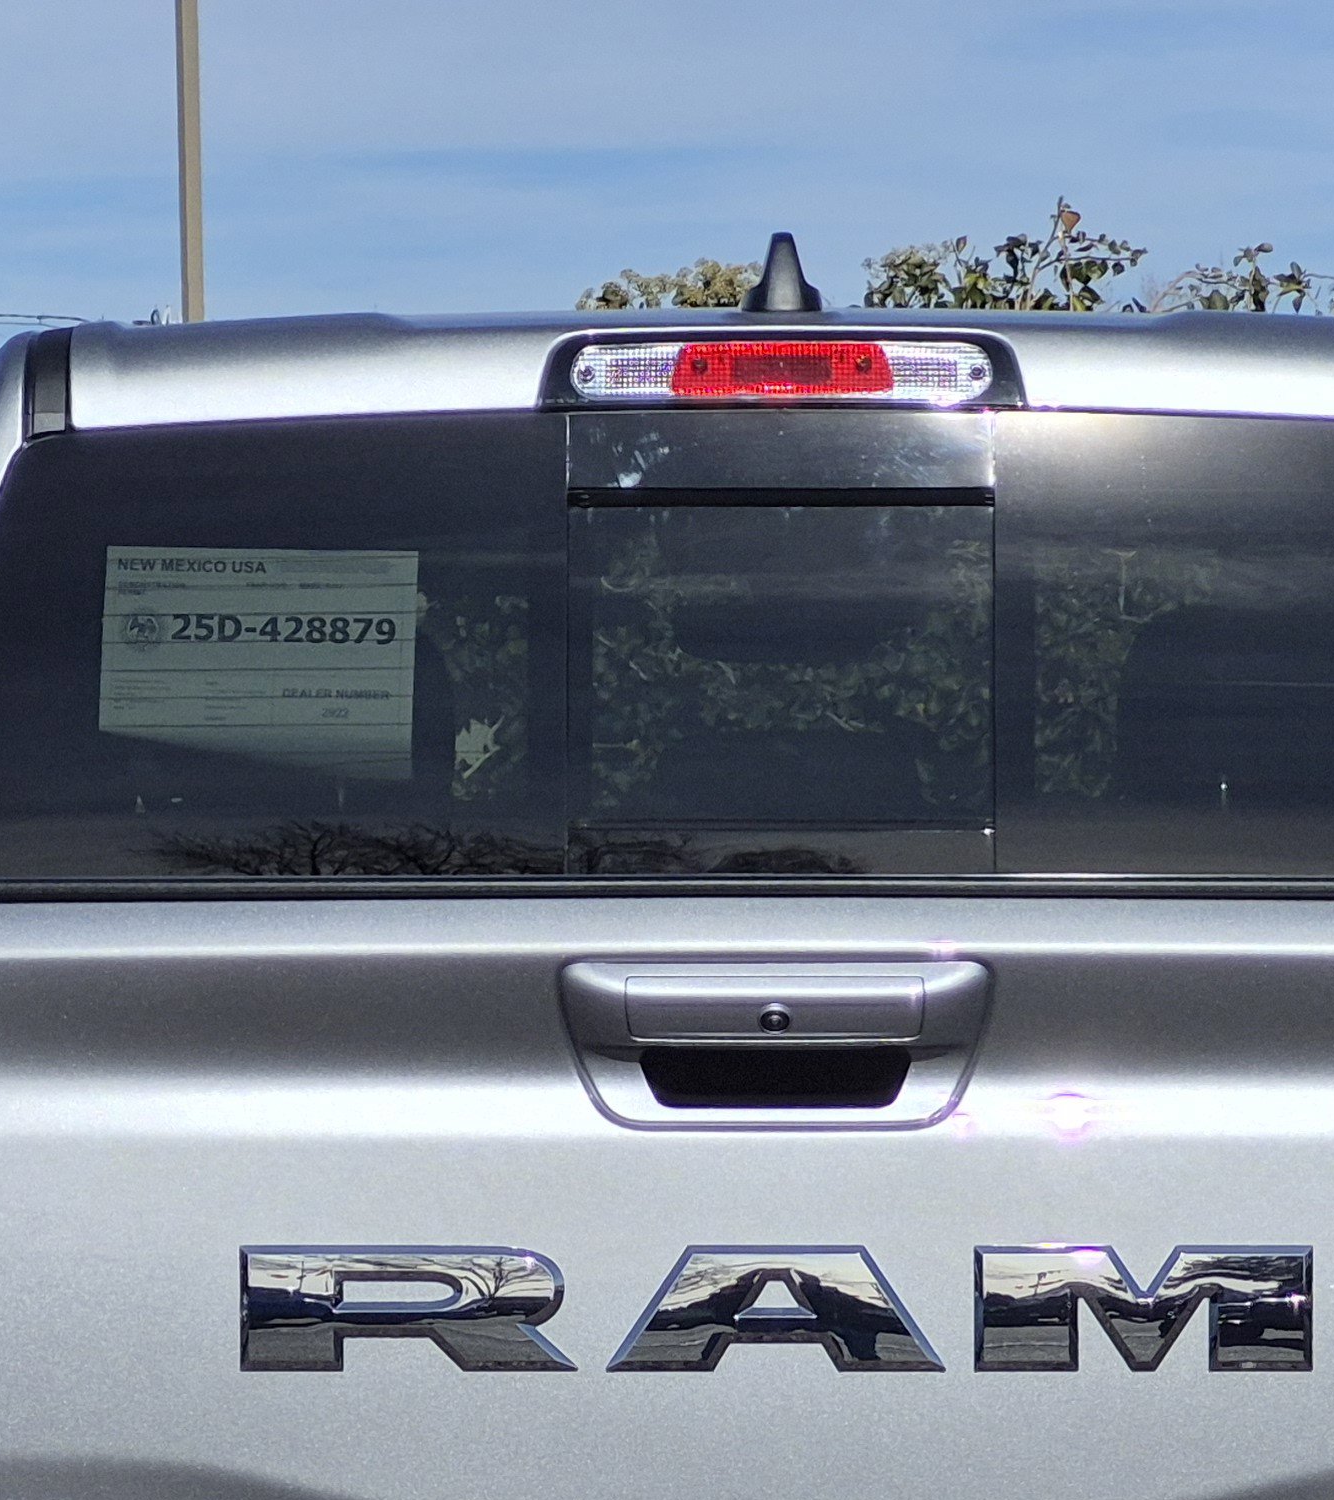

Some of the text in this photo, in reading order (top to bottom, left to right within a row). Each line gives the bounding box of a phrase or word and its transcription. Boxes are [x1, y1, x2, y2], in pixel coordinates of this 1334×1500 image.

[117, 558, 267, 574] NEW MEXICO USA
[170, 613, 396, 645] 25D-428879
[282, 688, 332, 699] DEALER
[239, 1244, 1314, 1372] RAM
